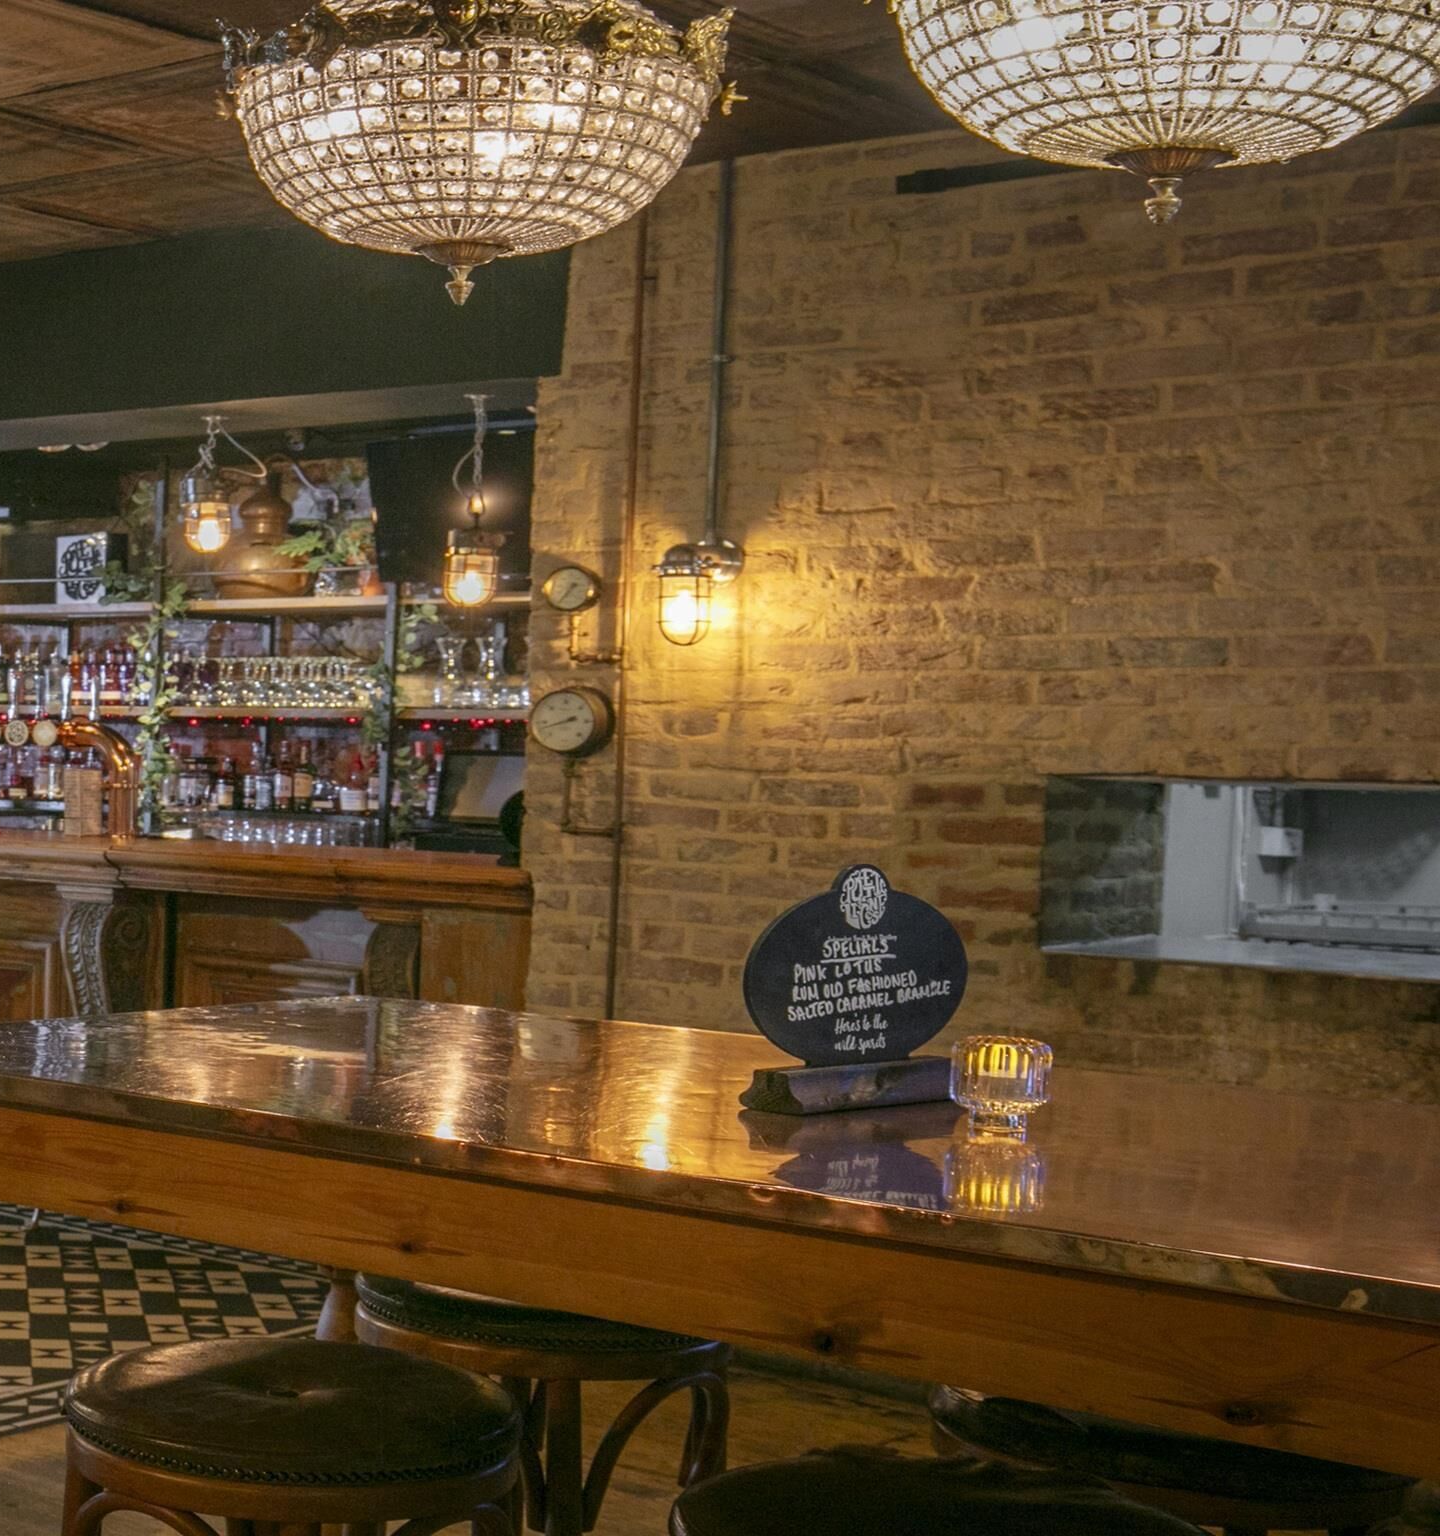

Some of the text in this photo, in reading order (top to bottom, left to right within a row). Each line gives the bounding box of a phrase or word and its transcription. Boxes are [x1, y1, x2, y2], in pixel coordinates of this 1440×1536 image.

[822, 938, 889, 958] SPECIALS
[793, 959, 882, 984] PINK LOTUS
[792, 969, 917, 1002] RUM OLD FASHIONED
[787, 980, 951, 1022] SALTED CARAMEL BRAMBLE
[834, 1012, 888, 1034] Here's to the
[858, 1032, 886, 1055] spirits
